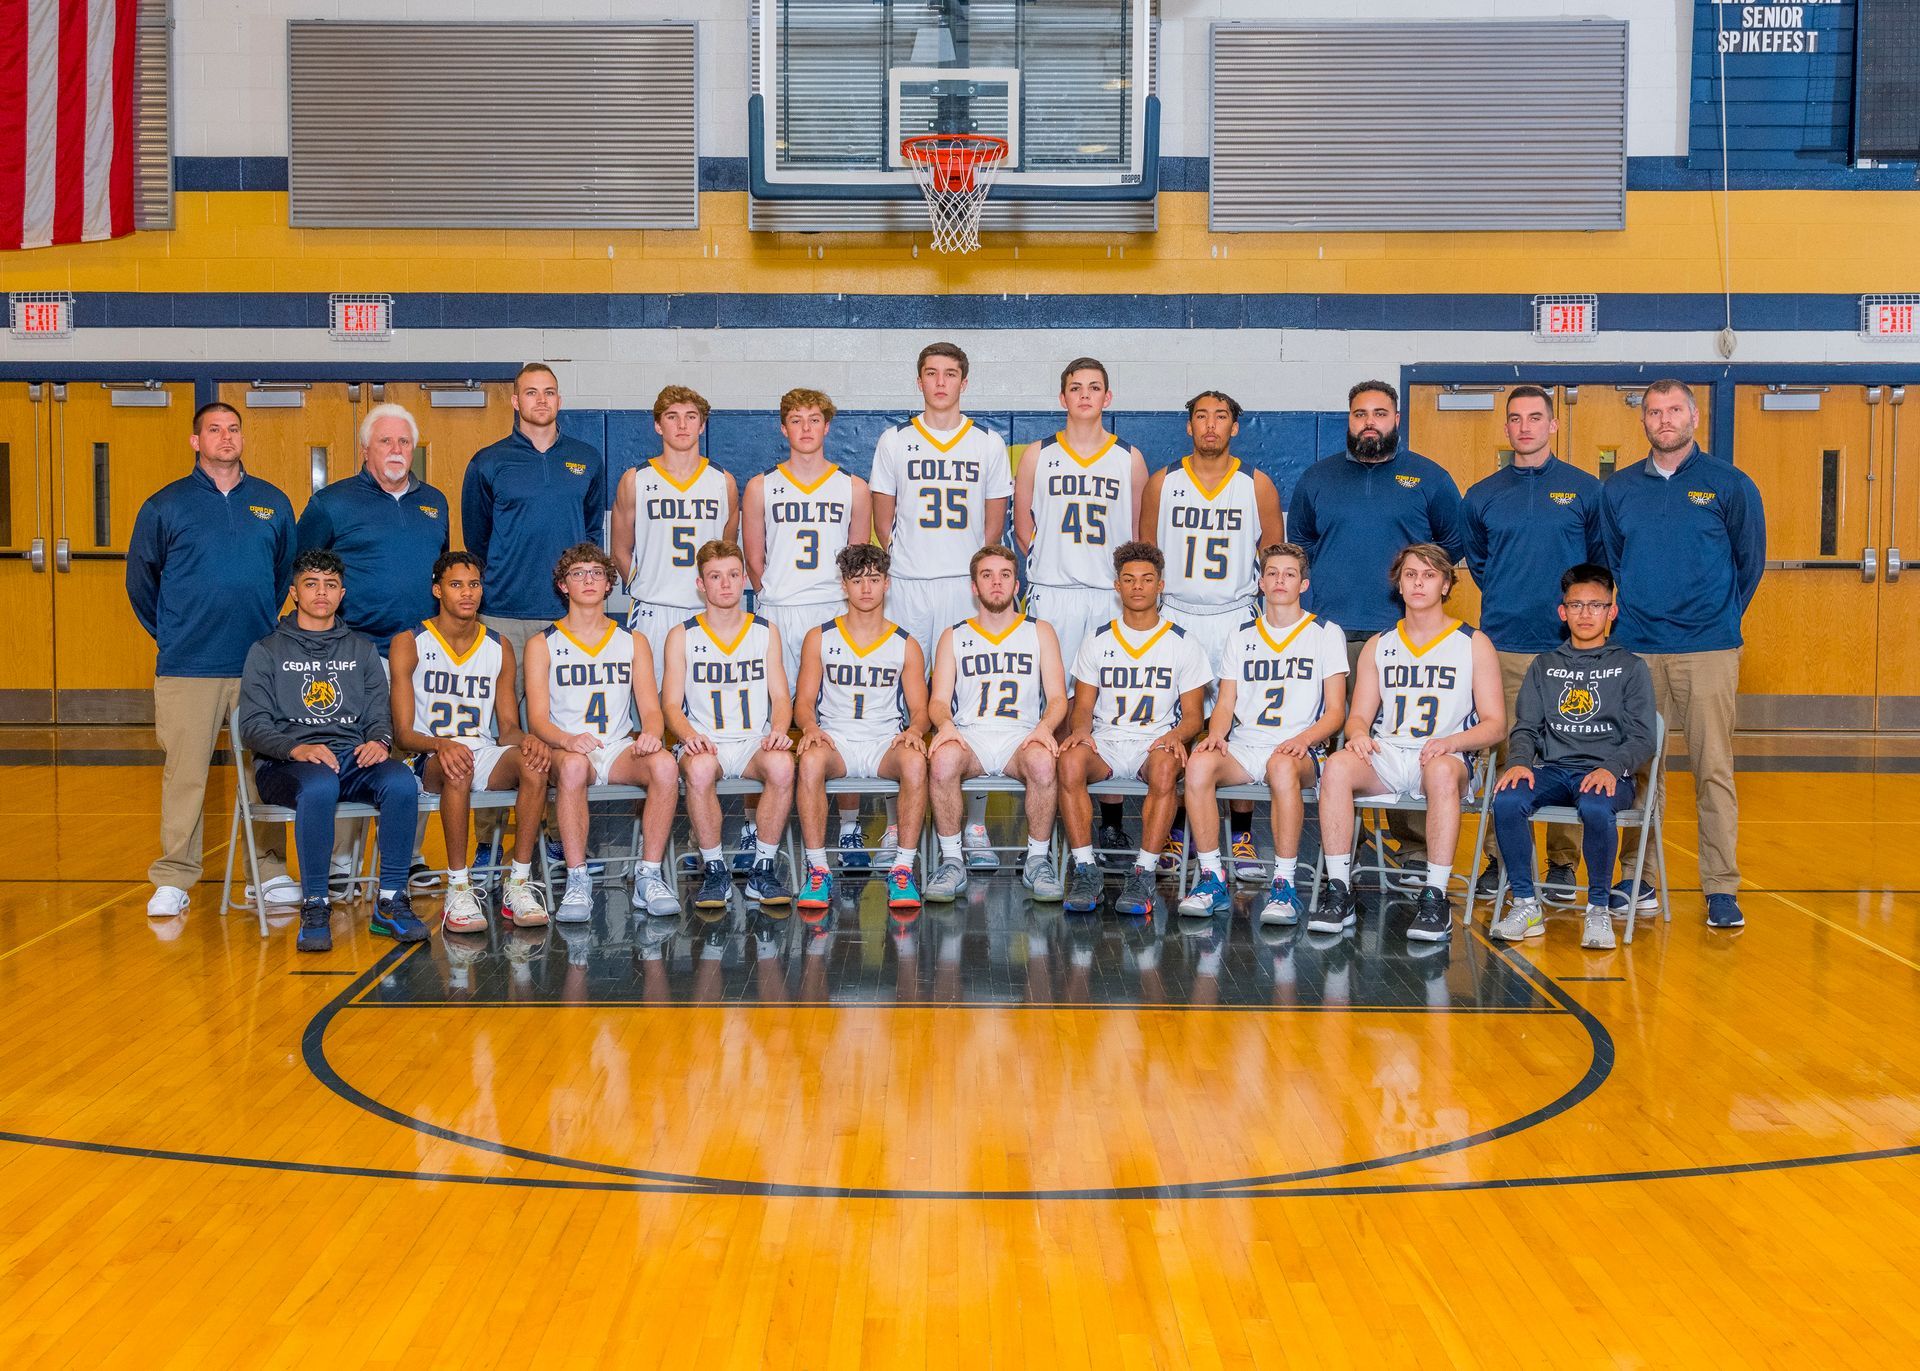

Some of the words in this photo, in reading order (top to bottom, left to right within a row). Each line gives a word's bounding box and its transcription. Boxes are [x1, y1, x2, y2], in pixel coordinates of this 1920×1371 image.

[1742, 6, 1803, 28] SENIOR
[1718, 31, 1818, 53] SPIKEFEST
[25, 304, 59, 331] EXIT
[344, 304, 379, 331] EXIT
[1550, 305, 1585, 332] EXIT
[1879, 306, 1912, 332] EXIT
[907, 459, 979, 482] COLTS
[1049, 475, 1120, 500] COLTS
[646, 498, 719, 520] COLTS
[771, 501, 845, 524] COLTS
[919, 487, 968, 530] 35
[1172, 506, 1242, 531] COLTS
[1061, 502, 1107, 546] 45
[672, 526, 696, 567] 5
[795, 529, 819, 570] 3
[1184, 535, 1229, 580] 15
[282, 660, 321, 671] CEDAR
[325, 660, 357, 671] CLIFF
[555, 662, 631, 687] COLTS
[693, 658, 765, 684] COLTS
[825, 663, 897, 687] COLTS
[961, 652, 1033, 677] COLTS
[1100, 666, 1172, 689] COLTS
[1243, 657, 1314, 682] COLTS
[1383, 664, 1456, 690] COLTS
[1546, 668, 1584, 680] CEDAR
[1589, 667, 1622, 680] CLIFF
[424, 670, 490, 698] COLTS
[710, 688, 752, 730] 11
[853, 693, 865, 719] 1
[977, 680, 1019, 719] 12
[1111, 694, 1155, 726] 14
[1256, 686, 1284, 728] 2
[429, 701, 481, 738] 22
[584, 692, 608, 734] 4
[1391, 694, 1440, 738] 13
